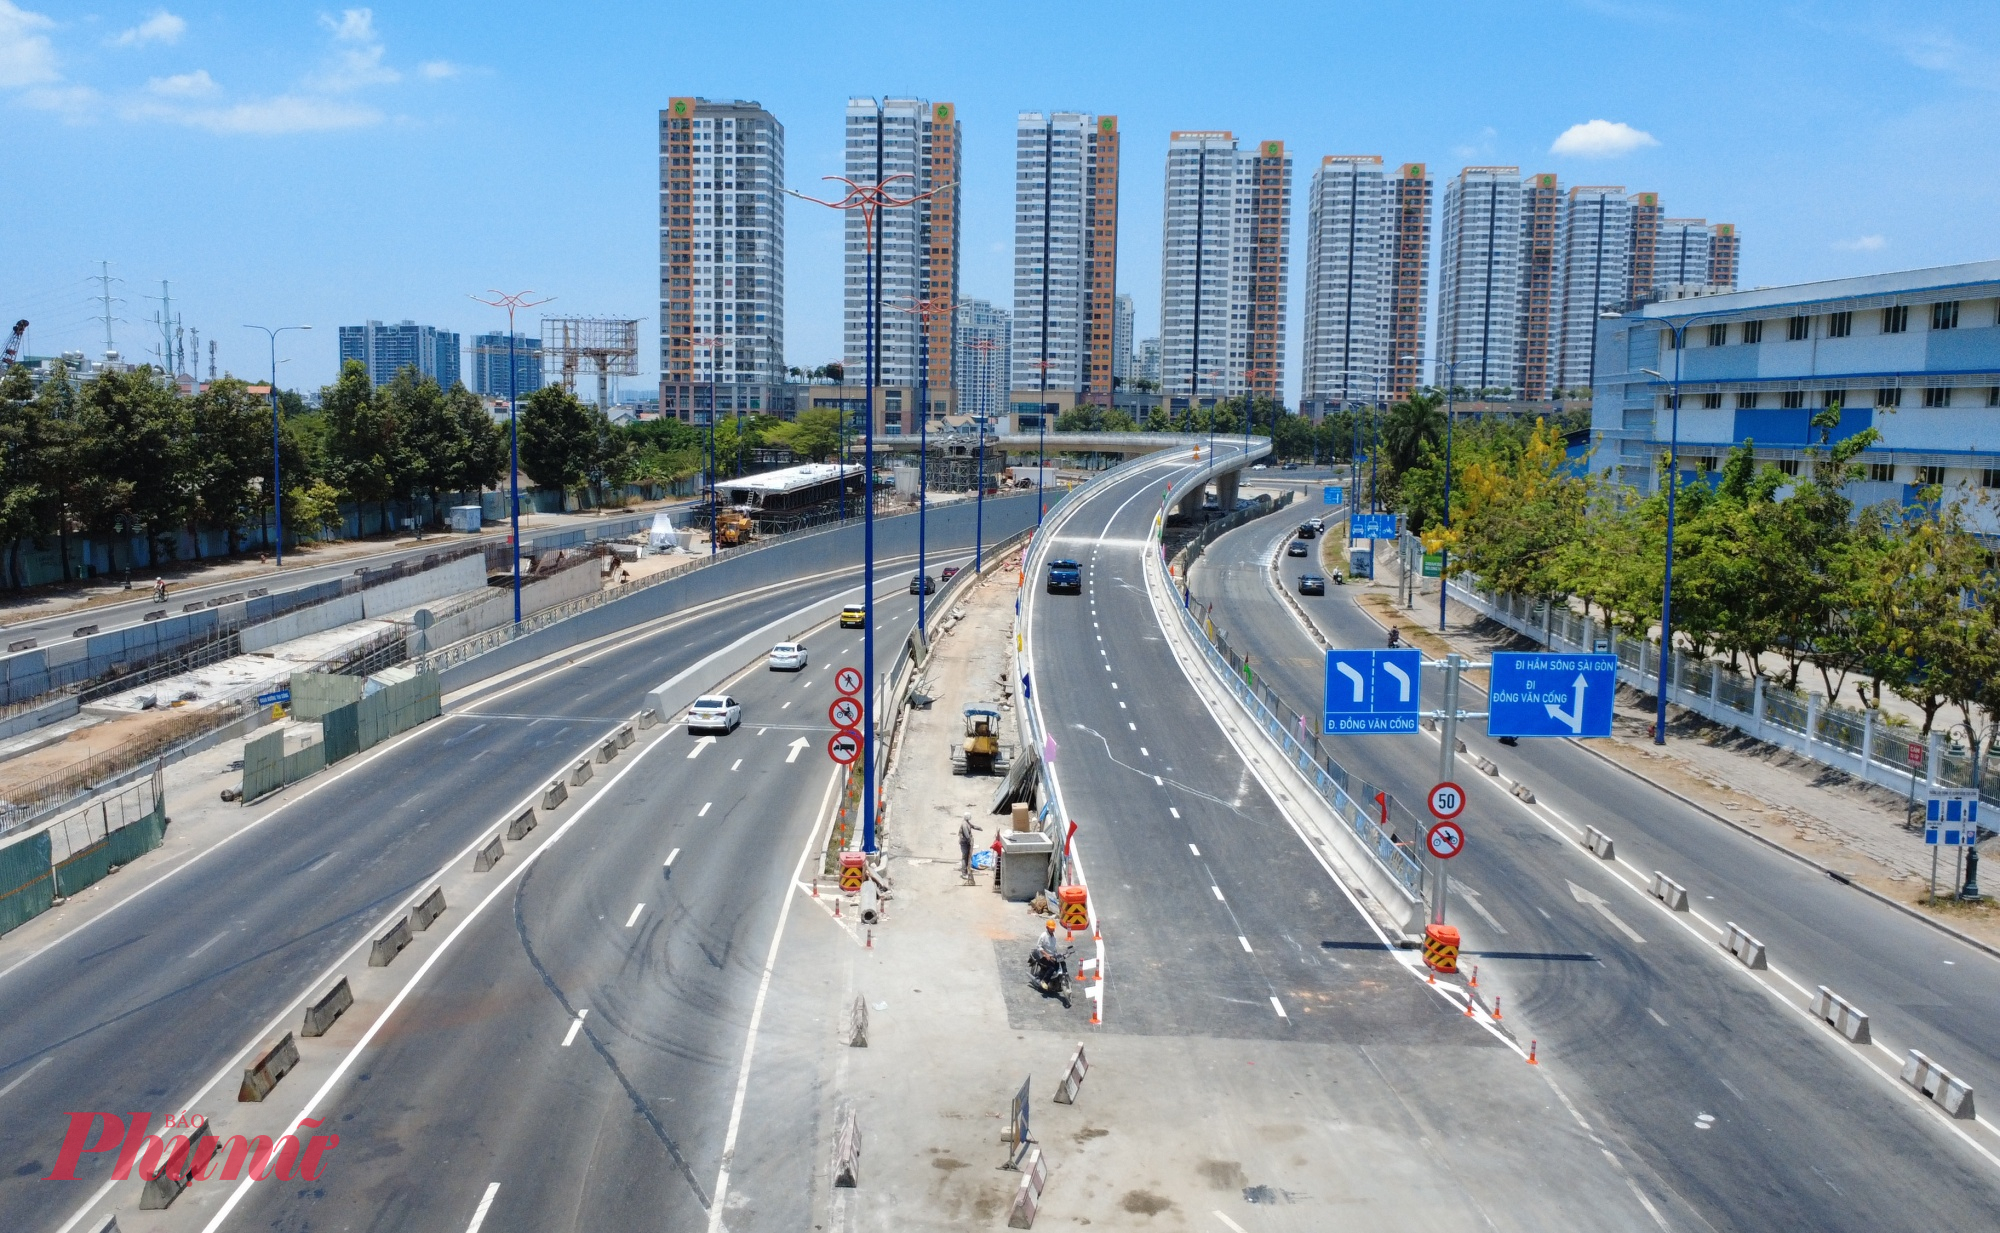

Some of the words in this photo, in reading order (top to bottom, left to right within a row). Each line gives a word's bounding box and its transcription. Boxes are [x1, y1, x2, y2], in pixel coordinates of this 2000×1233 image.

[1515, 660, 1525, 670] ĐI
[1550, 659, 1575, 671] SÔNG
[1577, 659, 1592, 671] SÀI
[1594, 660, 1614, 671] GÒN
[1526, 680, 1536, 690] ĐI
[1521, 691, 1540, 703] VĂN
[1542, 690, 1568, 703] CỐNG
[1368, 718, 1387, 730] VĂN
[1389, 716, 1415, 729] CỐNG
[1438, 793, 1455, 809] 50
